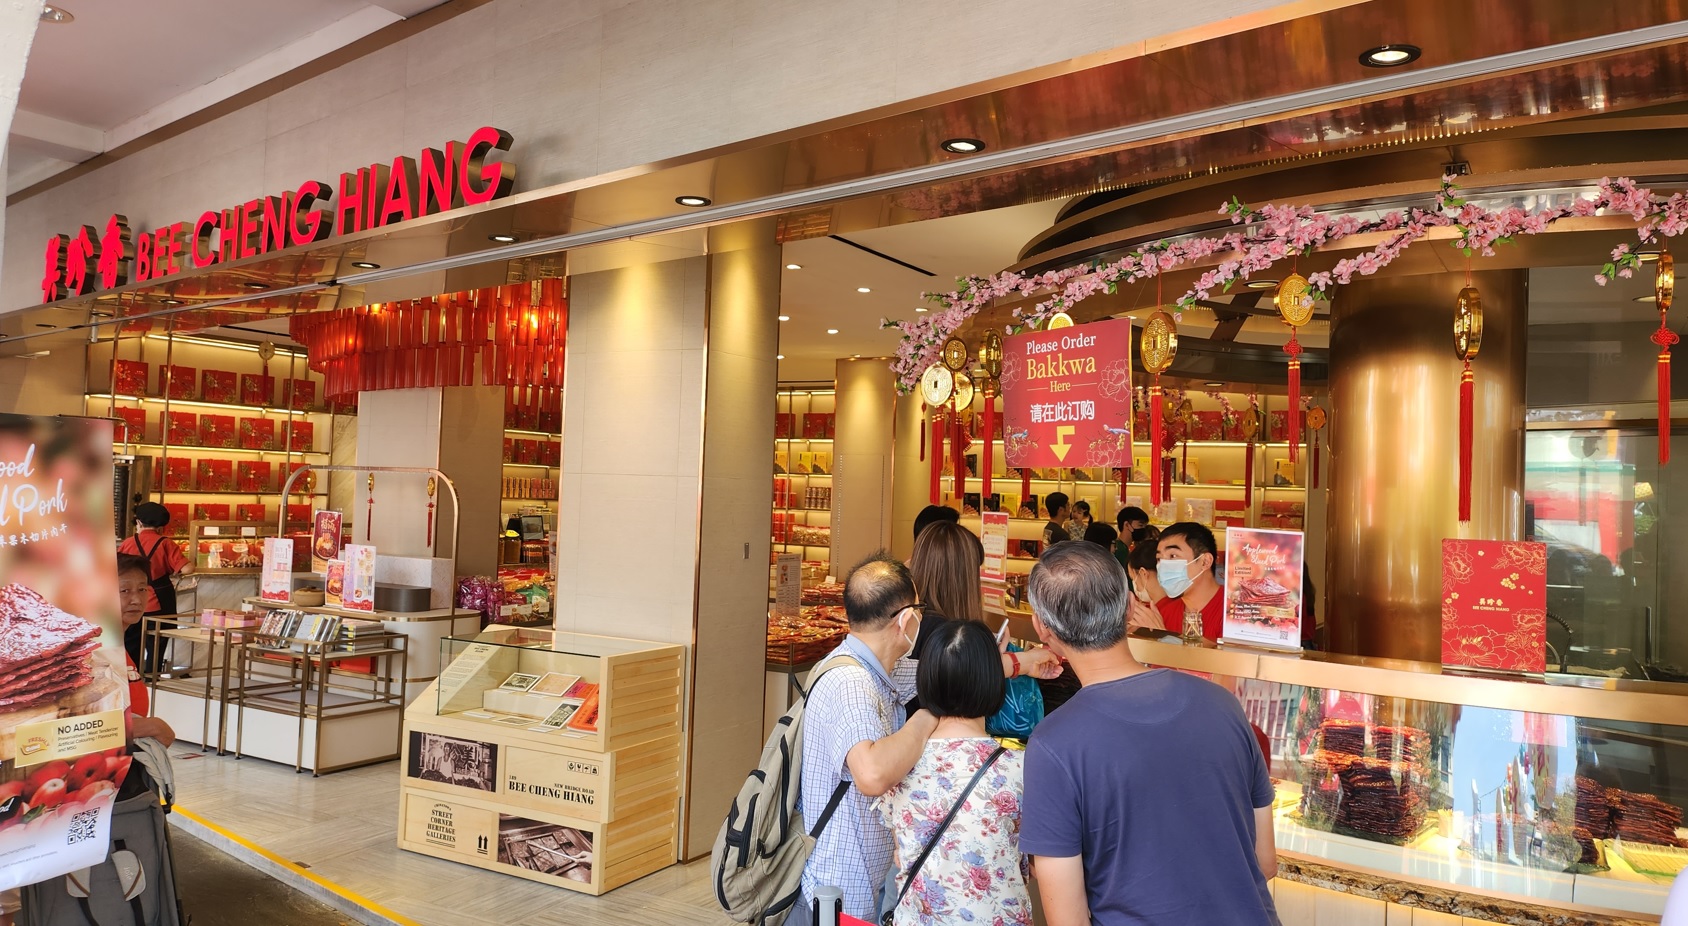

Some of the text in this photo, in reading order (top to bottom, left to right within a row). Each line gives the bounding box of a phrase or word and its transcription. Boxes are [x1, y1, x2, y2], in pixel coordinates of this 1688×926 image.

[136, 126, 508, 282] BEE CHENG HIANG
[42, 213, 130, 304] 美珍香
[1026, 332, 1097, 355] Please Order
[1026, 352, 1097, 380] Bakkwa
[1049, 380, 1071, 393] Here
[1030, 399, 1095, 423] 请在此订购
[12, 478, 68, 526] Pork
[1242, 543, 1278, 556] Applewood
[1251, 554, 1286, 566] Sliced Pork
[57, 719, 104, 735] NO ADDED
[57, 733, 86, 741] Preservatives
[99, 726, 119, 734] Tenderizer
[57, 731, 119, 747] Artificial Colouring Flavouring
[509, 780, 594, 805] BEE CHENG HIANG
[564, 784, 581, 792] BRIDGE
[430, 816, 453, 827] CORNER
[431, 809, 453, 820] STREET
[426, 830, 456, 843] GALLERIES
[427, 823, 456, 835] HERITAGE
